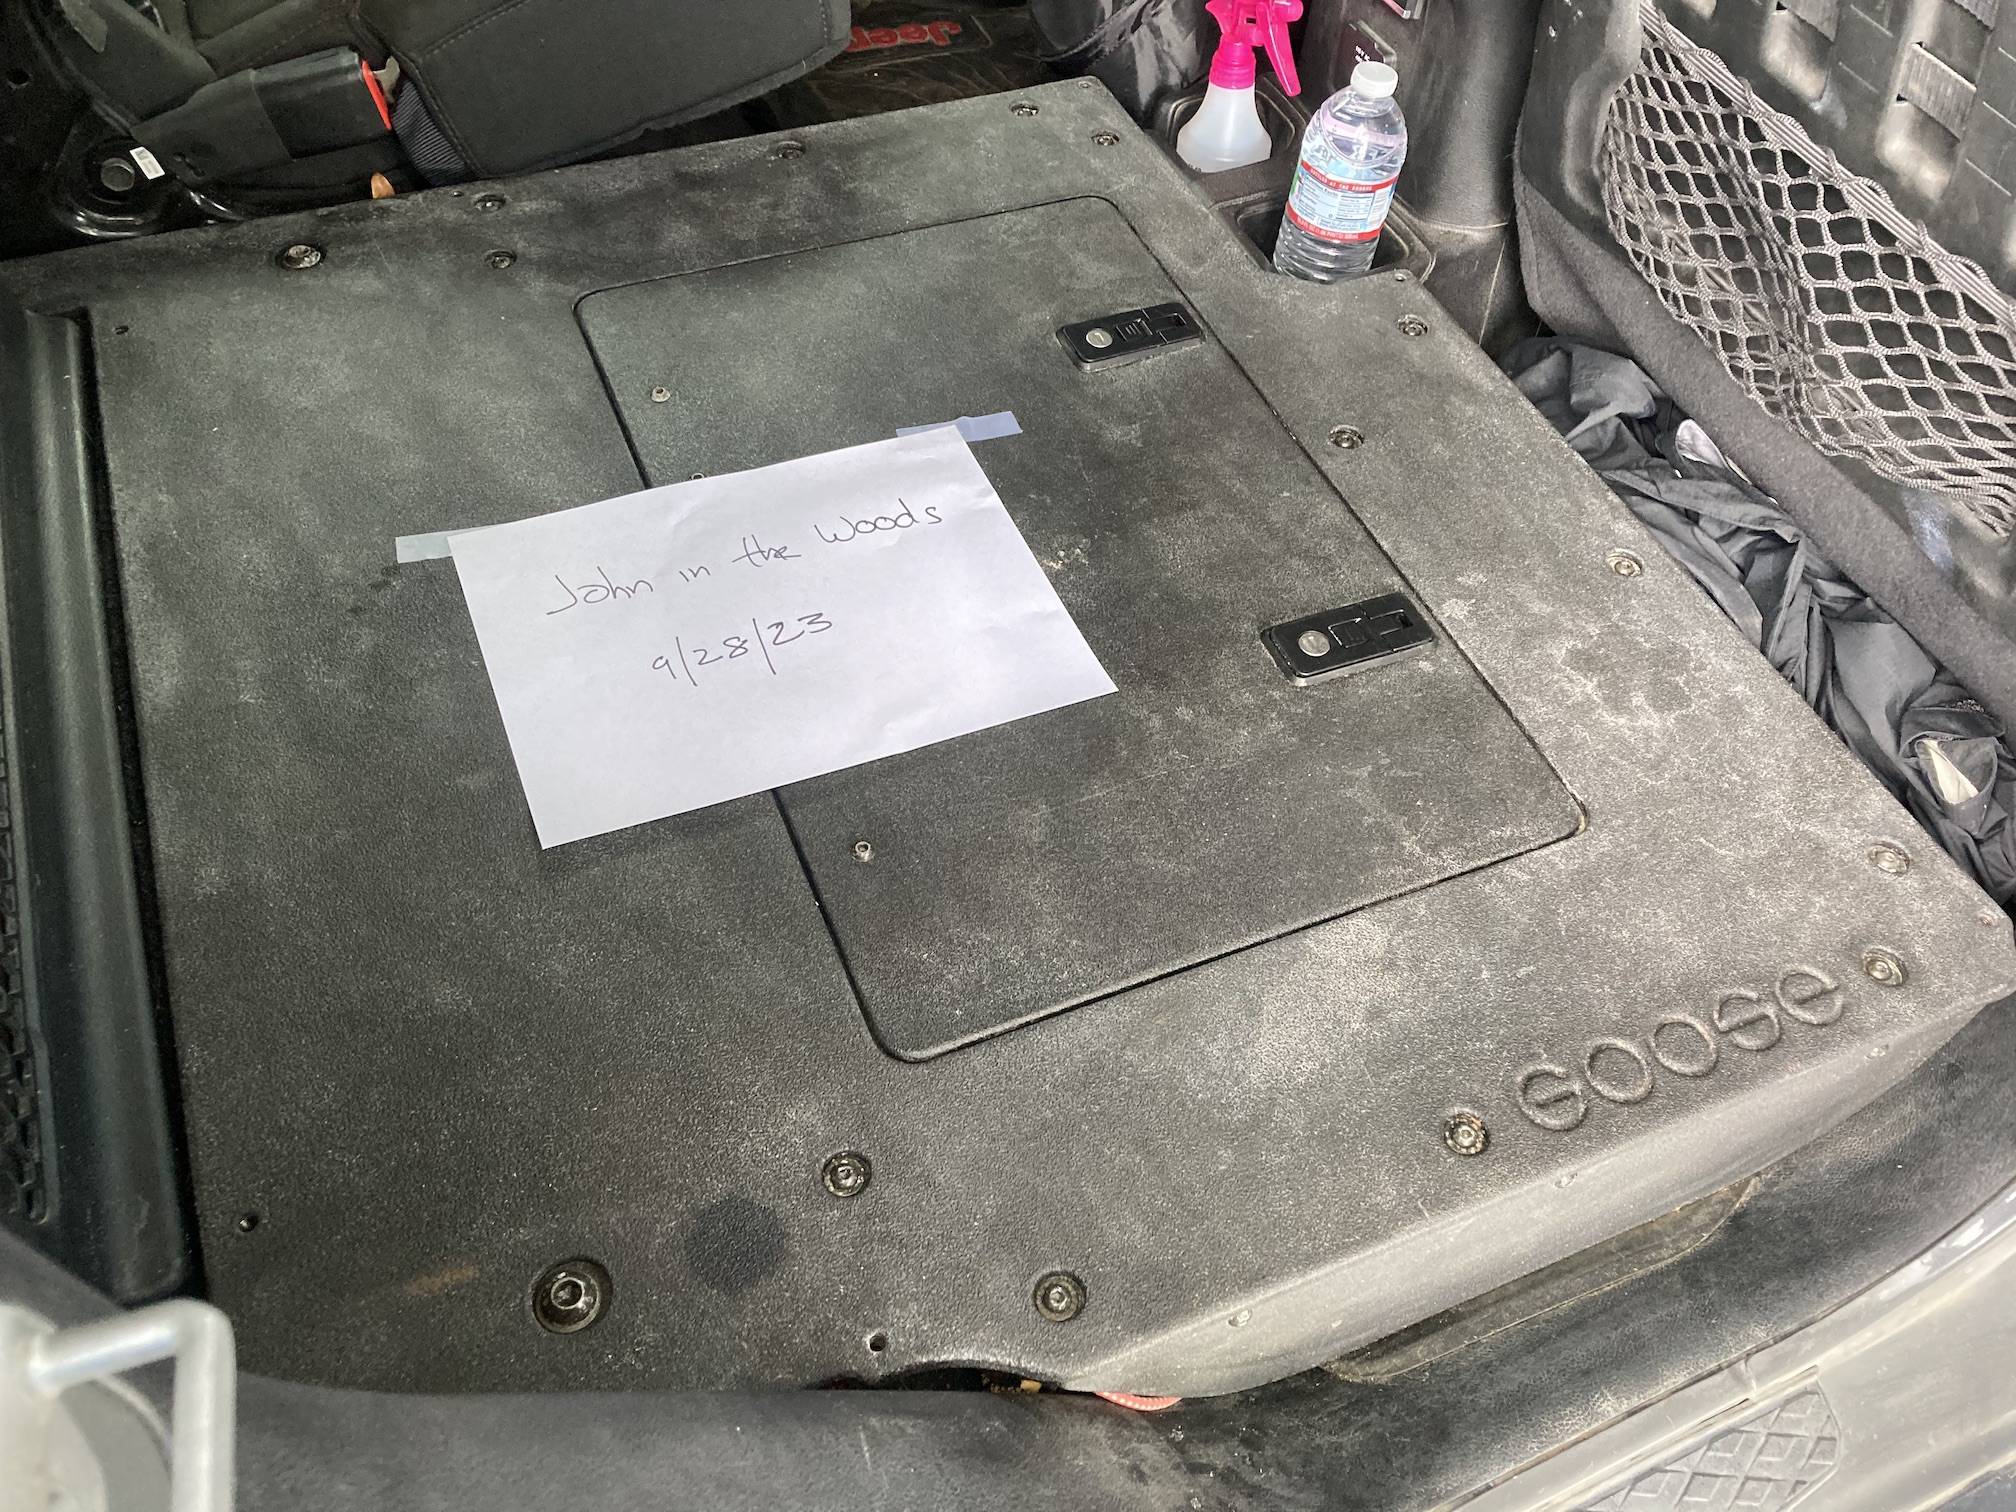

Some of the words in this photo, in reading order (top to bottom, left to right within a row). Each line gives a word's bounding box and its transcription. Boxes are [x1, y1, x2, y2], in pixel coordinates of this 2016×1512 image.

[547, 566, 653, 615] John
[679, 566, 711, 582] in
[731, 533, 802, 567] the
[814, 497, 943, 543] Woods
[652, 612, 833, 687] 9/28/23
